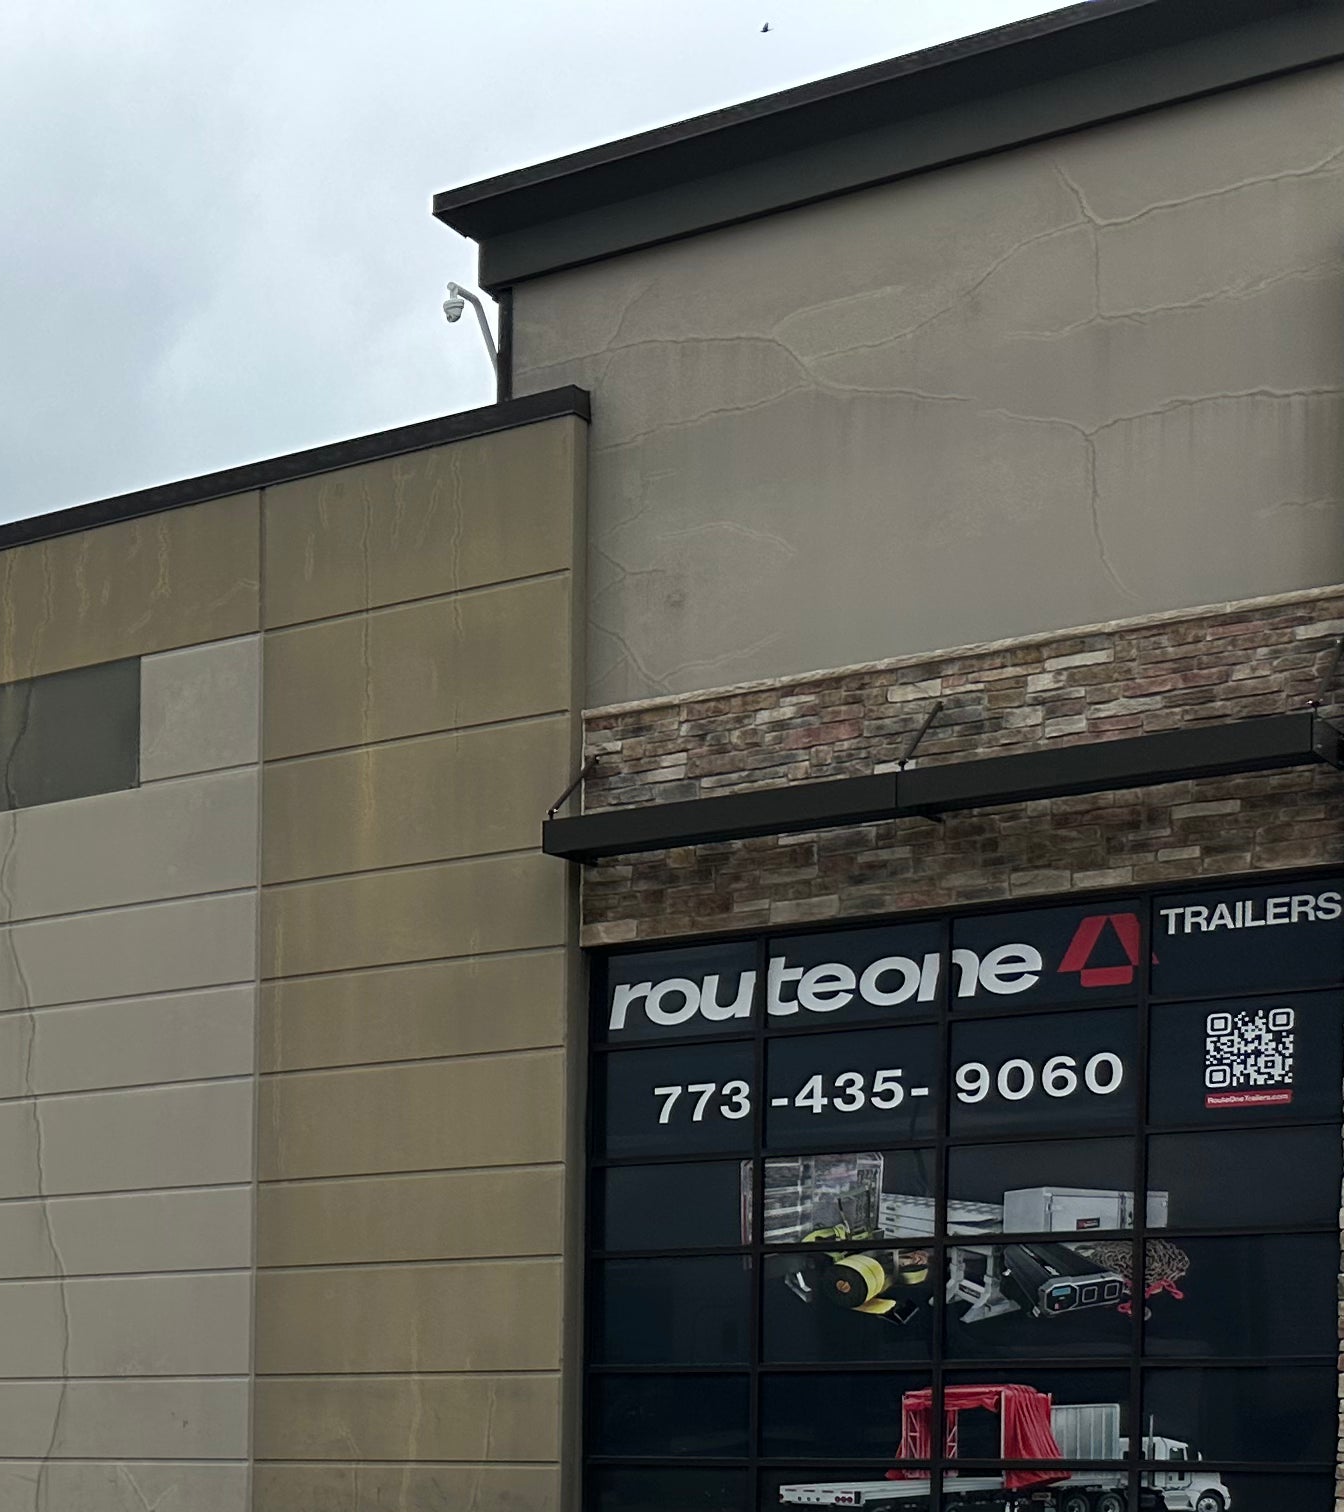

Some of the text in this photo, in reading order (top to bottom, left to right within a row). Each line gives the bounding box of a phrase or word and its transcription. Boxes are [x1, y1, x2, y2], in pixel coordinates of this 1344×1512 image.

[1160, 891, 1343, 935] TRAILERS
[609, 942, 1043, 1031] routeone
[654, 1080, 751, 1124] 773
[955, 1052, 1124, 1104] 9060
